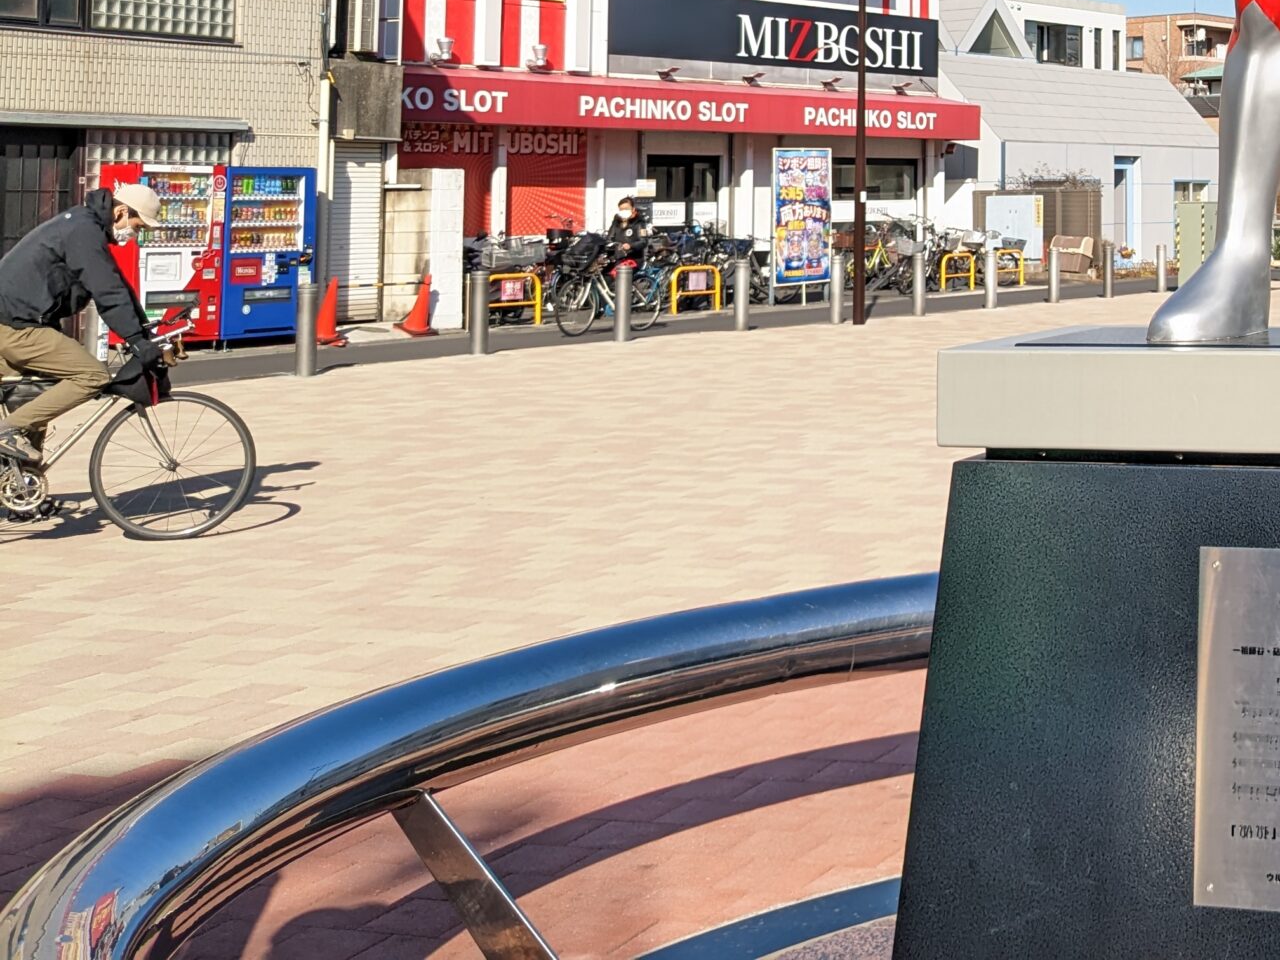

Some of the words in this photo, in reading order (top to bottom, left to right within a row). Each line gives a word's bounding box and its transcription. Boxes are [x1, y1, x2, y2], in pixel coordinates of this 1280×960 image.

[443, 88, 509, 113] SLOT
[579, 95, 692, 121] PACHINKO
[698, 100, 749, 123] SLOT
[896, 110, 937, 130] SLOT
[404, 129, 440, 140] パチンコ
[453, 131, 579, 155] MITUBOSHI
